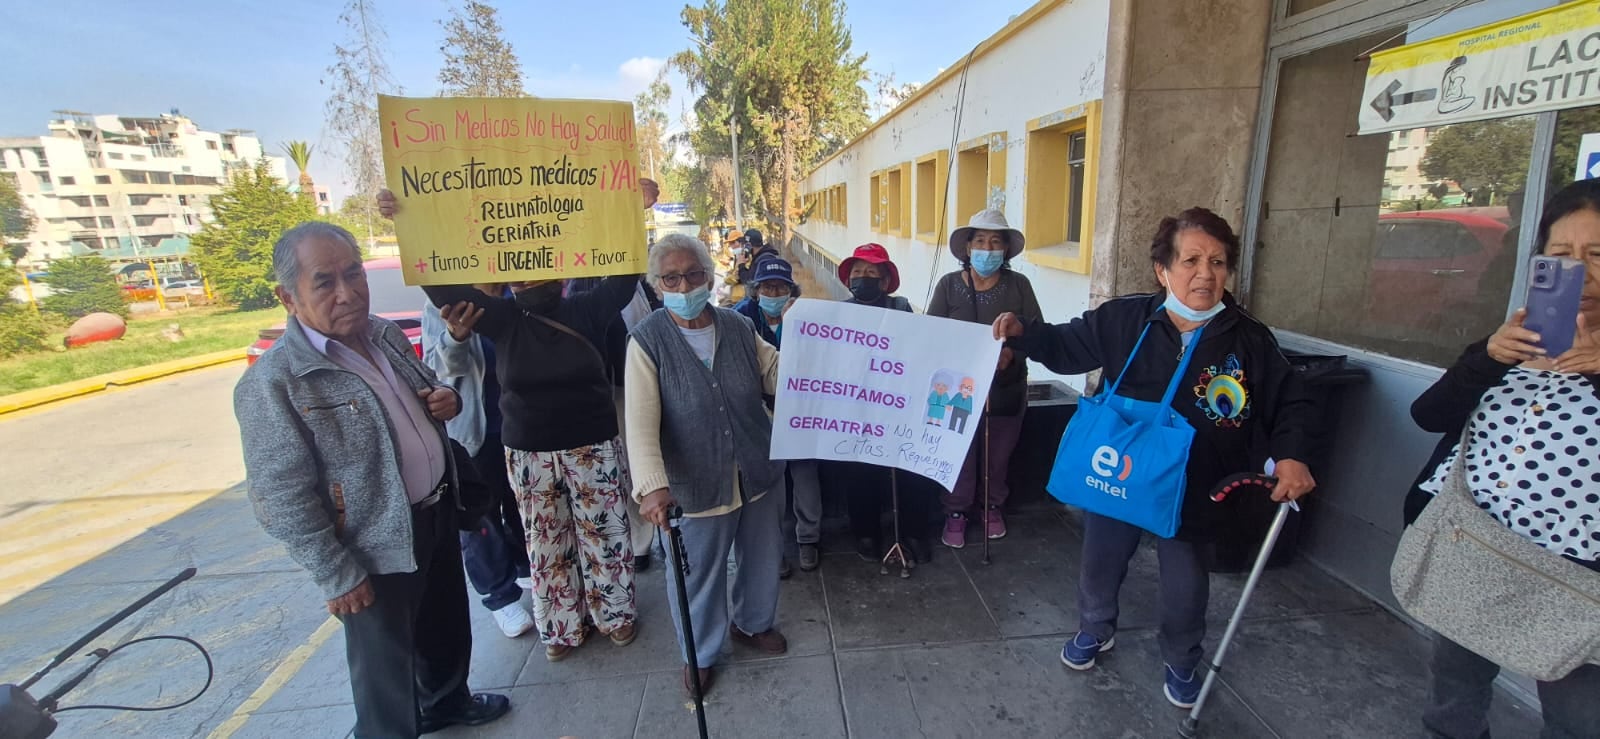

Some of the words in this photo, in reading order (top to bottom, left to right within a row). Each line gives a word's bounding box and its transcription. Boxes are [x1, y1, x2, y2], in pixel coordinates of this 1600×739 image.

[1459, 33, 1496, 47] HOSPITAL
[1498, 22, 1542, 38] REGIONAL
[1527, 32, 1600, 72] LAC
[1482, 68, 1600, 110] INSTIT
[455, 104, 520, 140] Medicos
[525, 110, 545, 138] No
[551, 111, 580, 151] Hay
[585, 111, 634, 149] Salud!
[401, 156, 523, 197] Necesitamos
[530, 154, 598, 187] médicos
[600, 159, 637, 193] ¡YA!
[428, 249, 479, 272] turnos
[870, 358, 905, 375] LOS
[787, 378, 906, 409] NECESITAMOS
[789, 416, 885, 437] GERIATRAS
[894, 424, 913, 438] No
[922, 428, 942, 454] hay
[1085, 475, 1128, 500] entel
